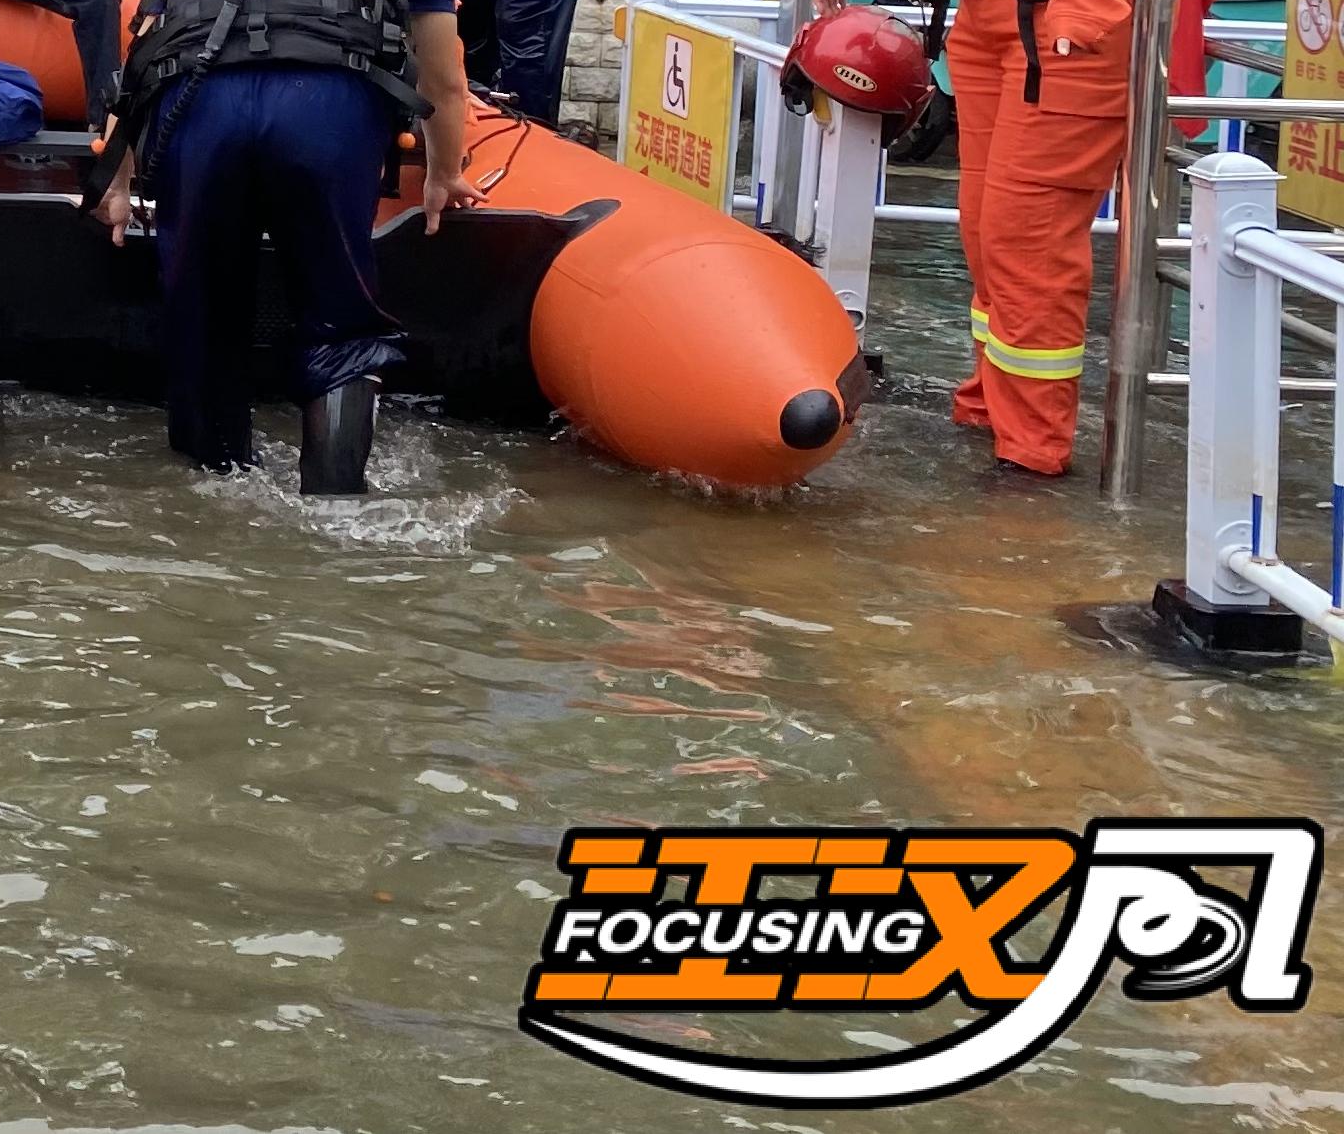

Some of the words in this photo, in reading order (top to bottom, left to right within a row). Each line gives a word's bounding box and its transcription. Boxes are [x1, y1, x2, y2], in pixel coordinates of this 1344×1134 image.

[635, 111, 713, 188] 无障碍通道
